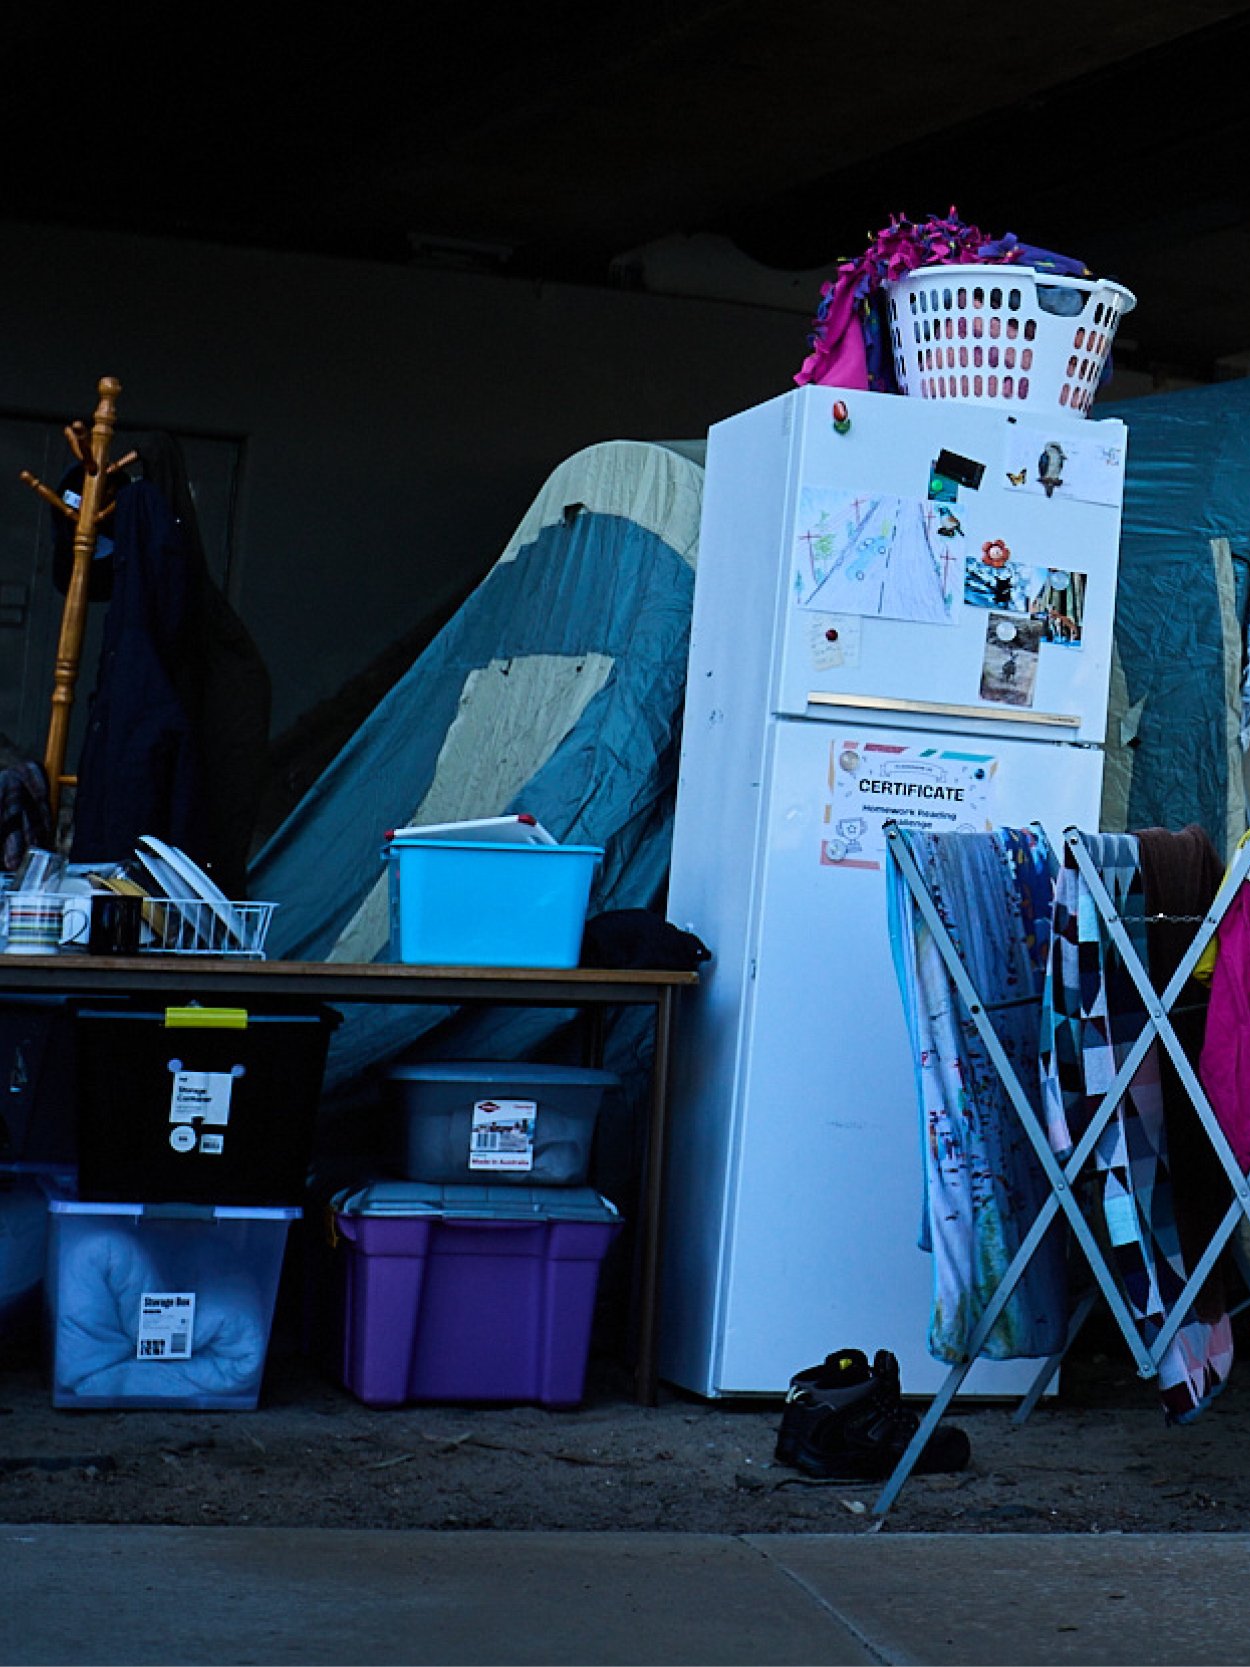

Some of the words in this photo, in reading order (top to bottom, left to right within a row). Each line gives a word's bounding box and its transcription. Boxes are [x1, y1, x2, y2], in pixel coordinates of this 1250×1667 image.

[859, 778, 965, 802] CERTIFICATE
[862, 804, 915, 816] Homework
[917, 808, 957, 822] Reading
[885, 816, 933, 829] allenge
[144, 1296, 174, 1310] Storage
